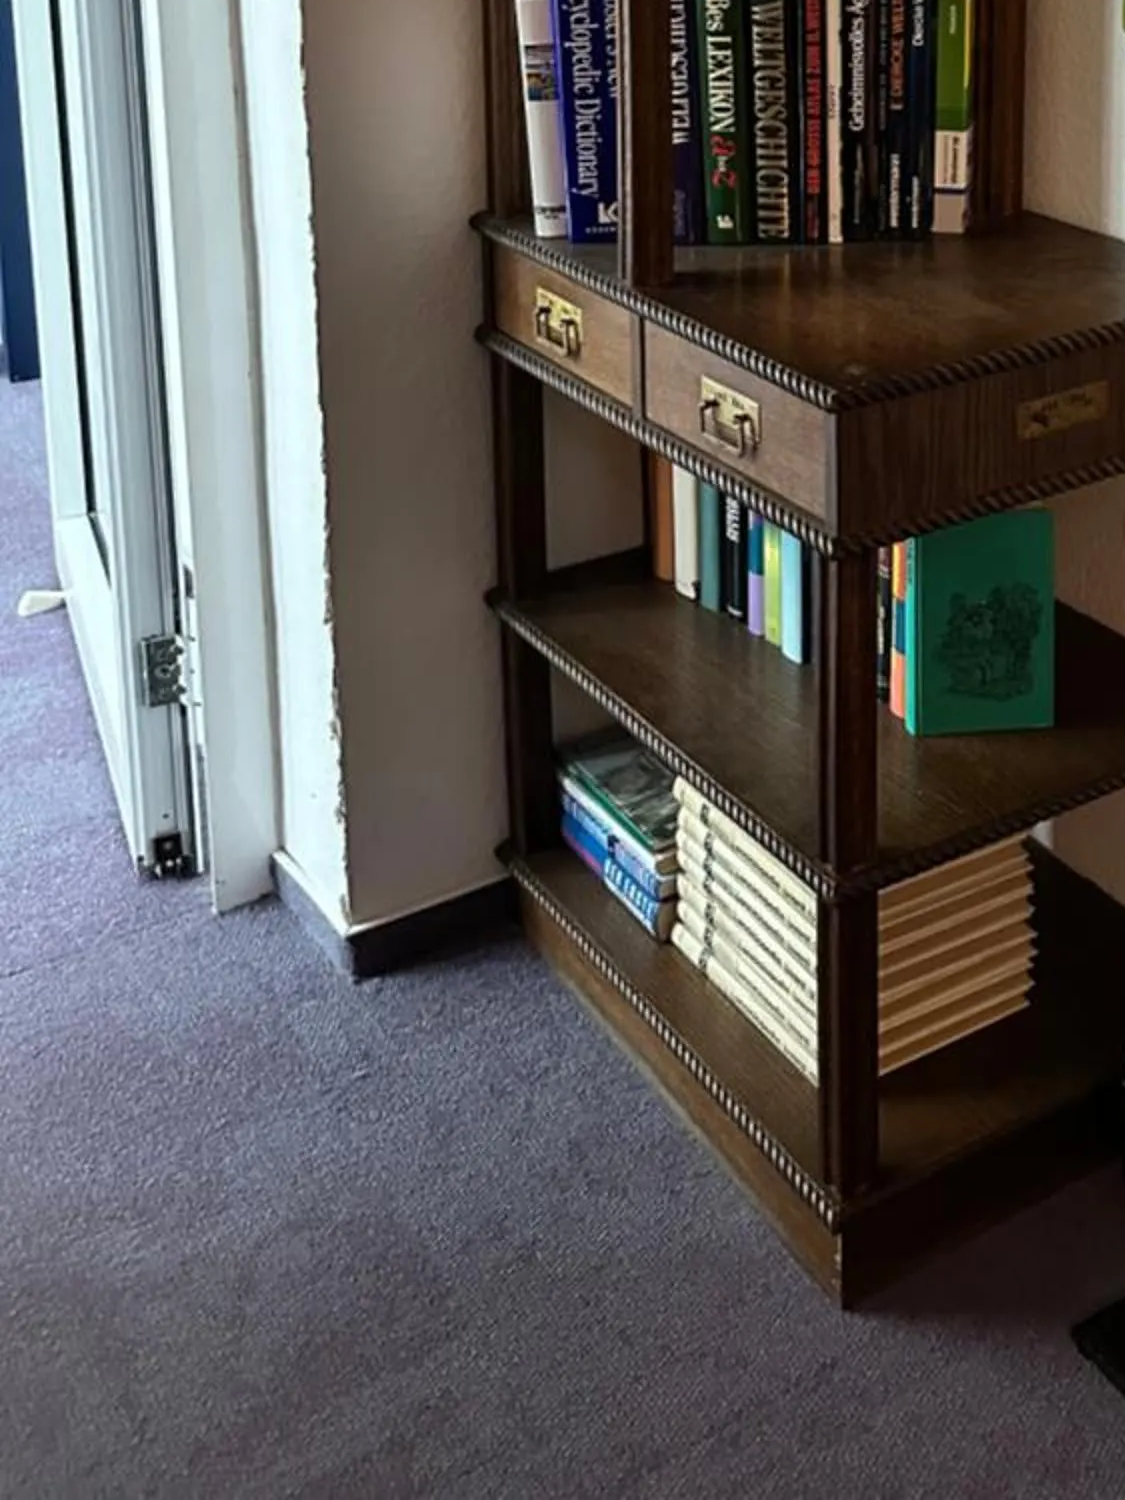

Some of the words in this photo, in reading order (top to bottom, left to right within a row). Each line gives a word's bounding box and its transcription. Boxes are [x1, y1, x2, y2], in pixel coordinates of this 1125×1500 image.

[706, 35, 736, 133] LEXIKON
[847, 17, 865, 132] Geheimnisvolles
[571, 97, 603, 198] Dictionary
